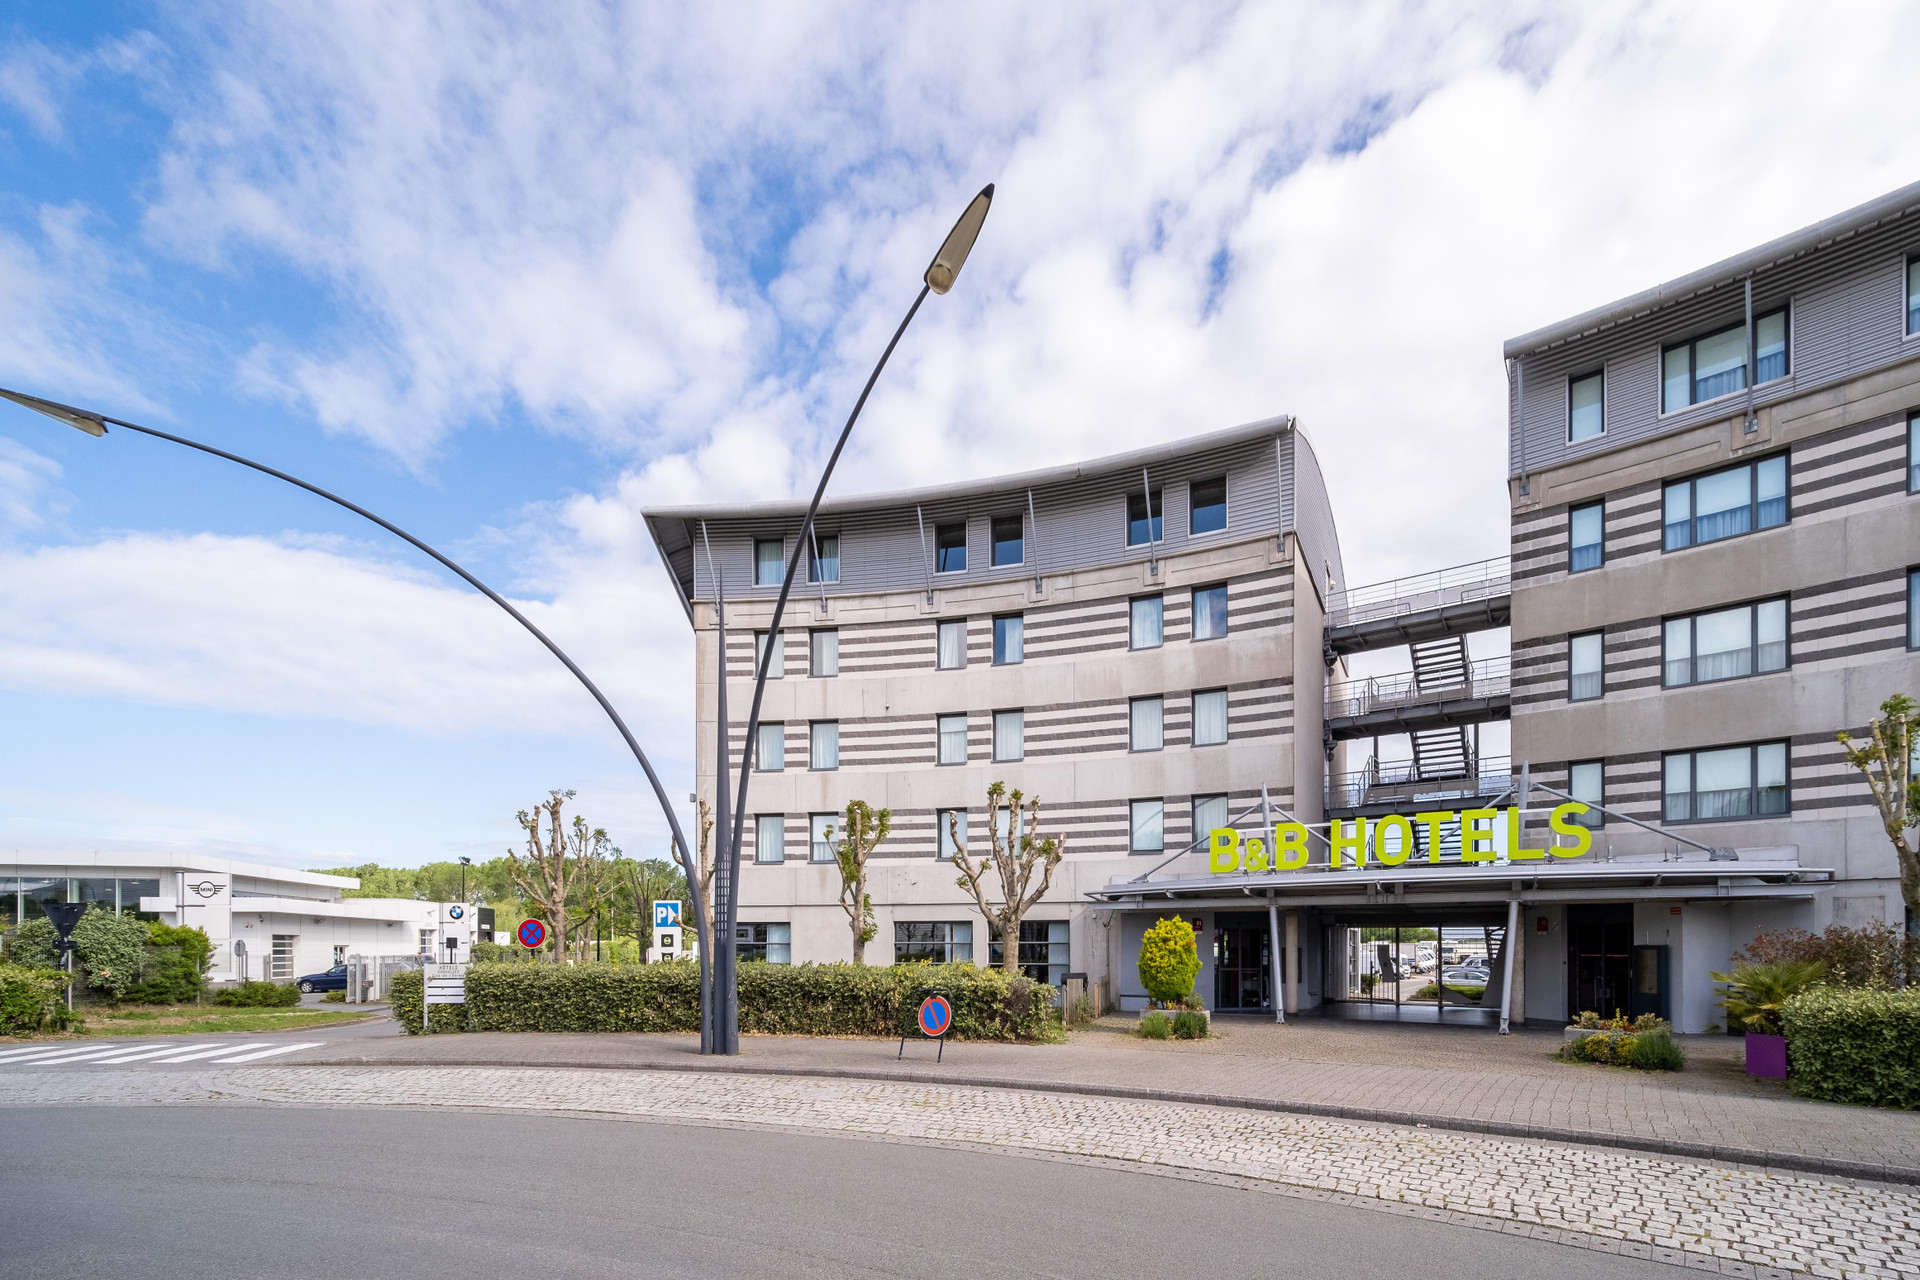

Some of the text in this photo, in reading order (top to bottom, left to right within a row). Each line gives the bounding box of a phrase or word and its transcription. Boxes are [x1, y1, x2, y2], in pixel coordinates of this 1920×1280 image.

[1209, 802, 1593, 874] B&B HOTELS
[657, 907, 667, 923] P
